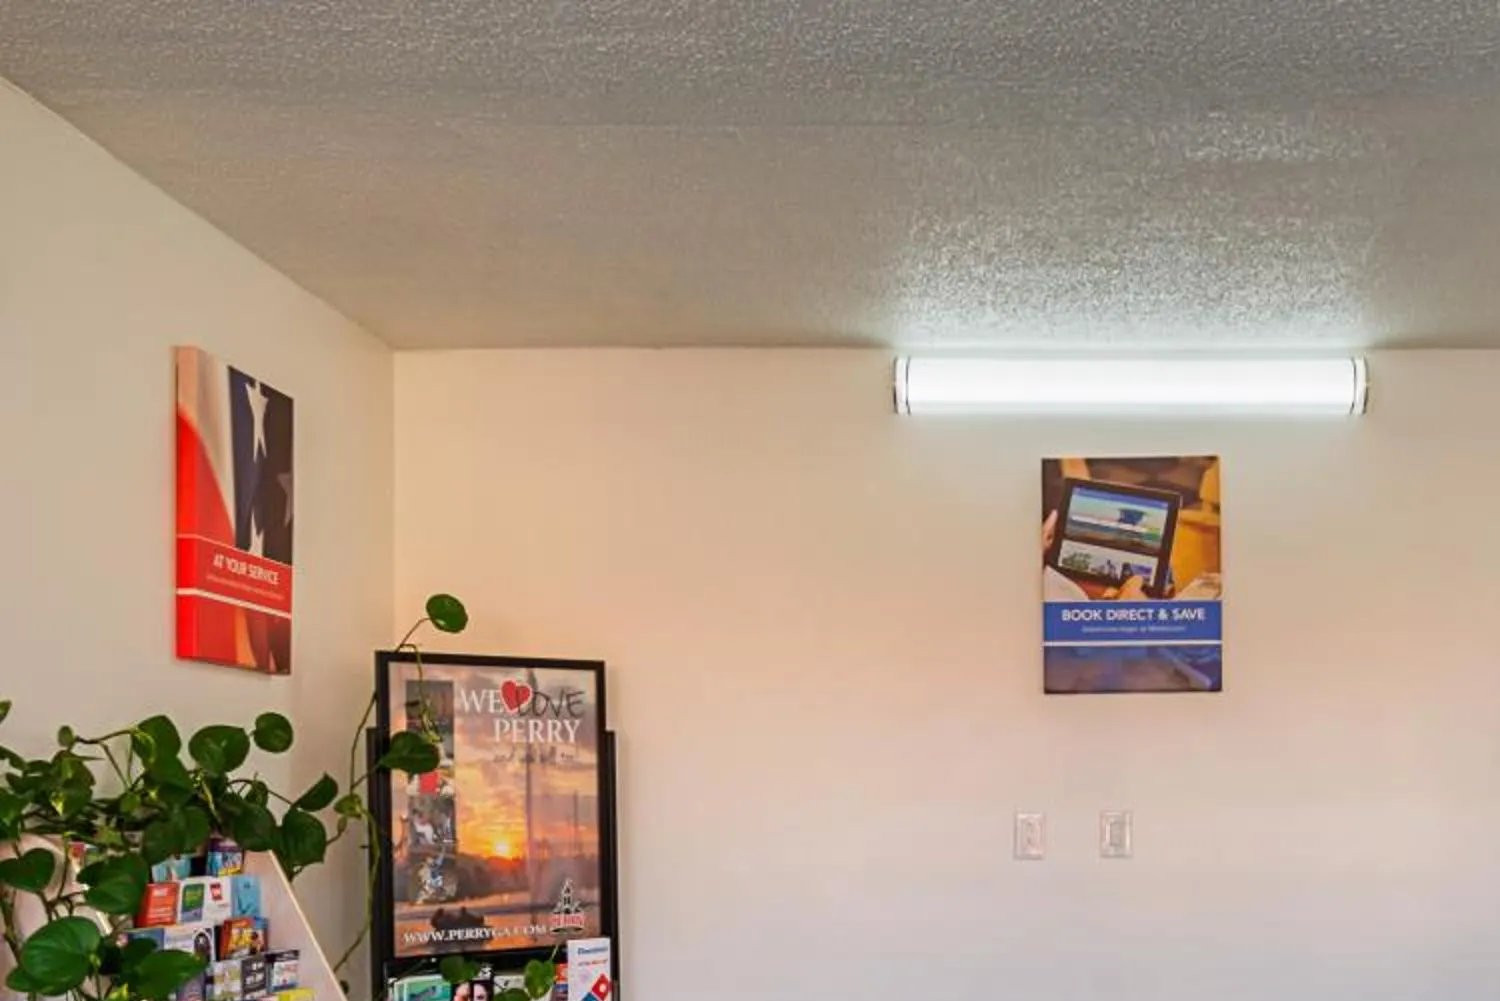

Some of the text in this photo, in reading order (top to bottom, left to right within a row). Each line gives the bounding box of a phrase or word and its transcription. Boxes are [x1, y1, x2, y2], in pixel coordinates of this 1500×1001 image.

[213, 553, 280, 585] AT YOUR SERVICE
[1061, 608, 1206, 621] BOOK DIRECT & SAVE
[460, 688, 504, 713] WE
[493, 719, 581, 743] PERRY
